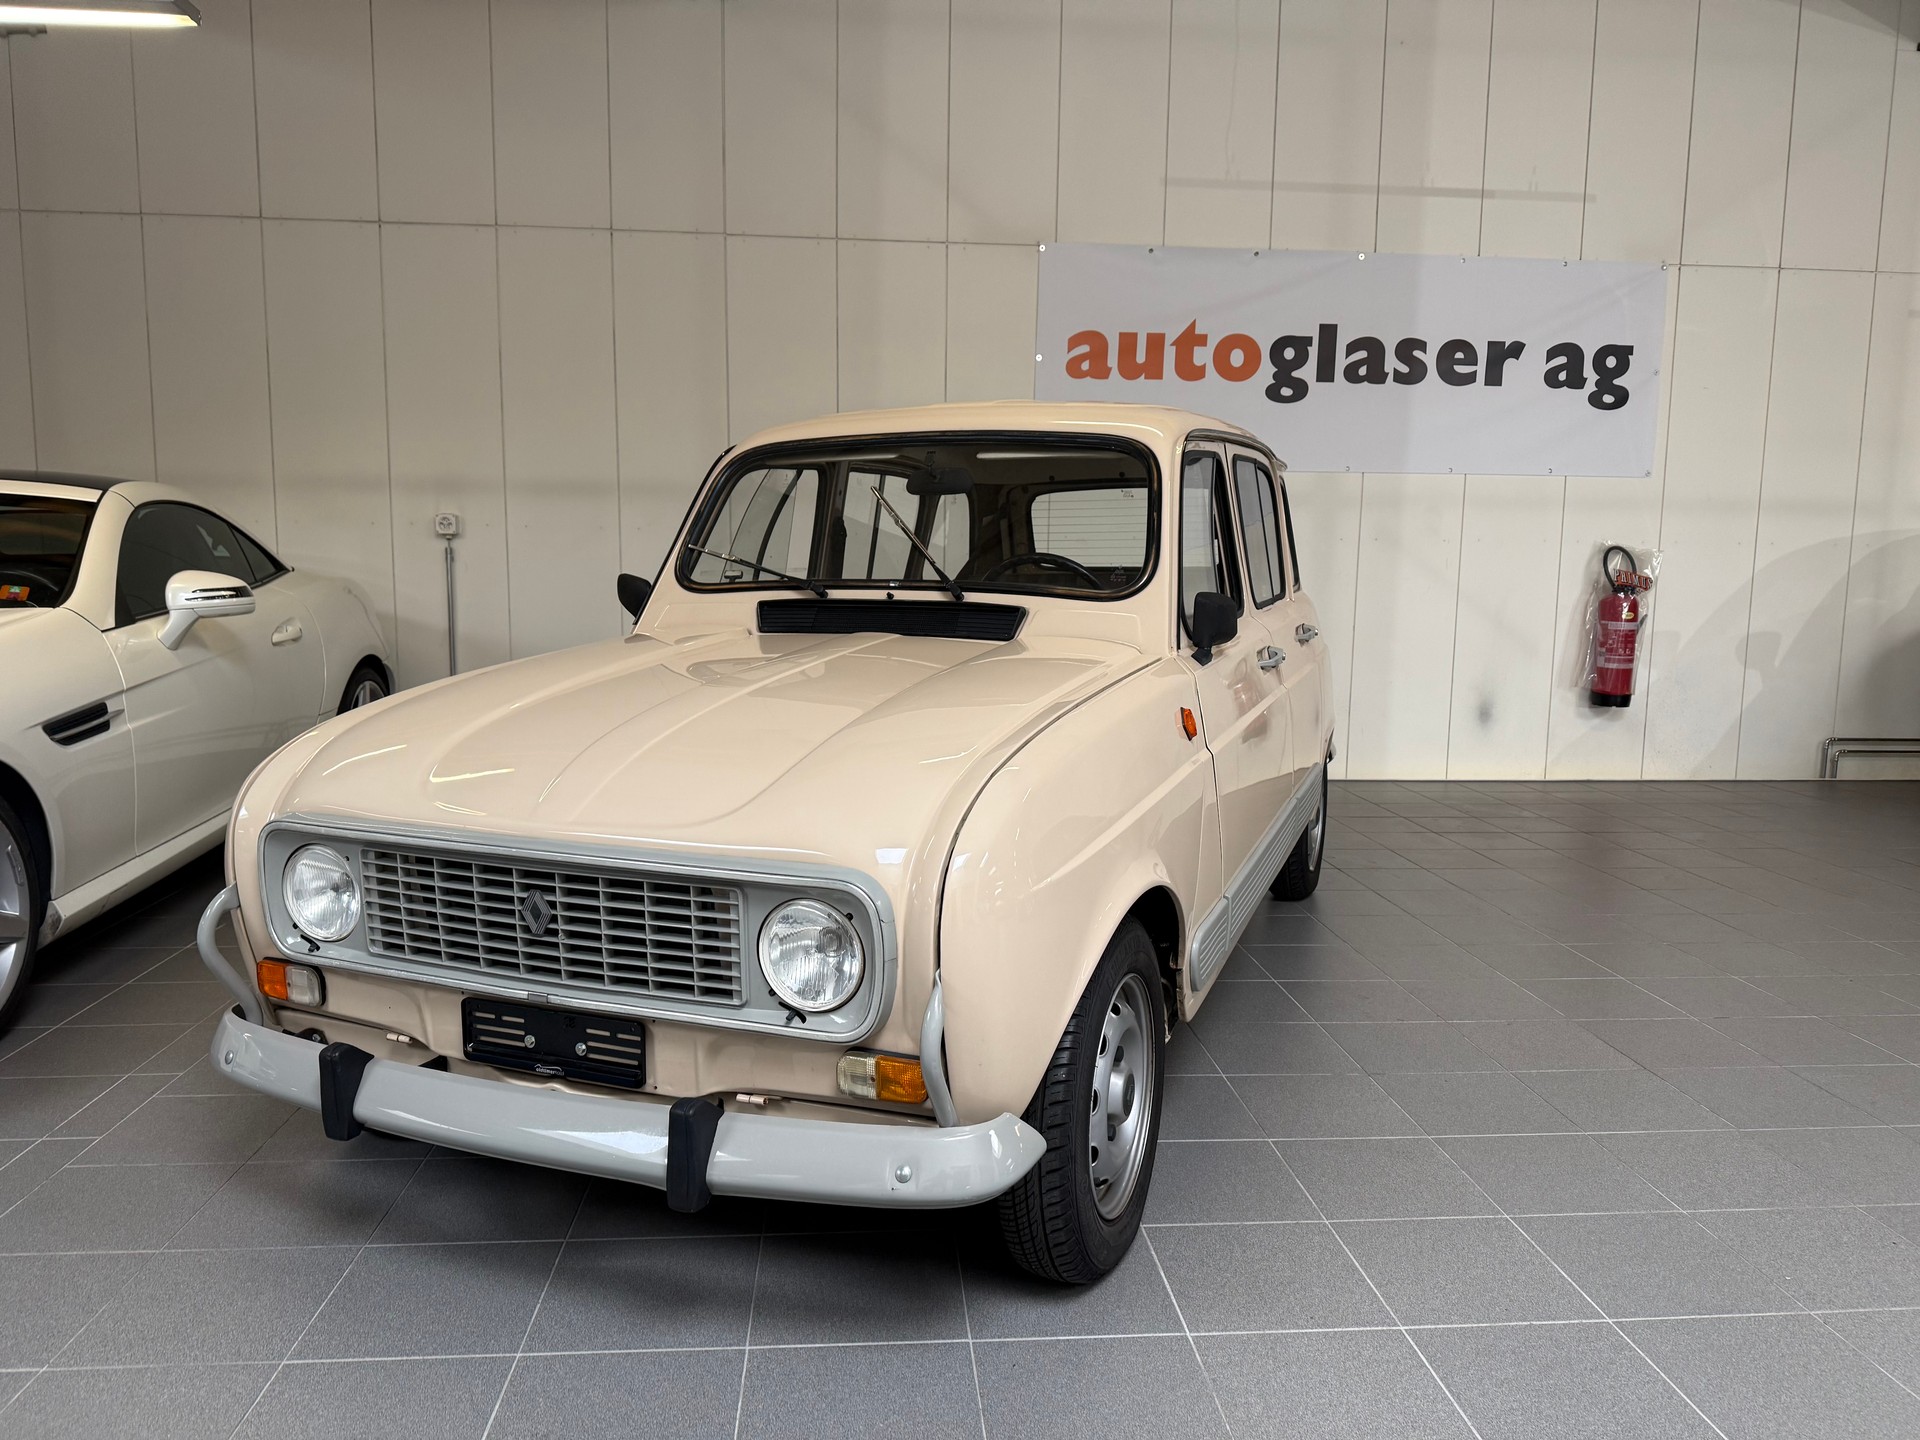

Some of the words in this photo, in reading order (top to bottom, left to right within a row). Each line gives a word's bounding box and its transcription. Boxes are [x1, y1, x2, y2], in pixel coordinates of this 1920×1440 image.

[1065, 319, 1527, 404] autoglaser
[1543, 342, 1634, 411] ag
[1614, 569, 1653, 590] PRIMUS
